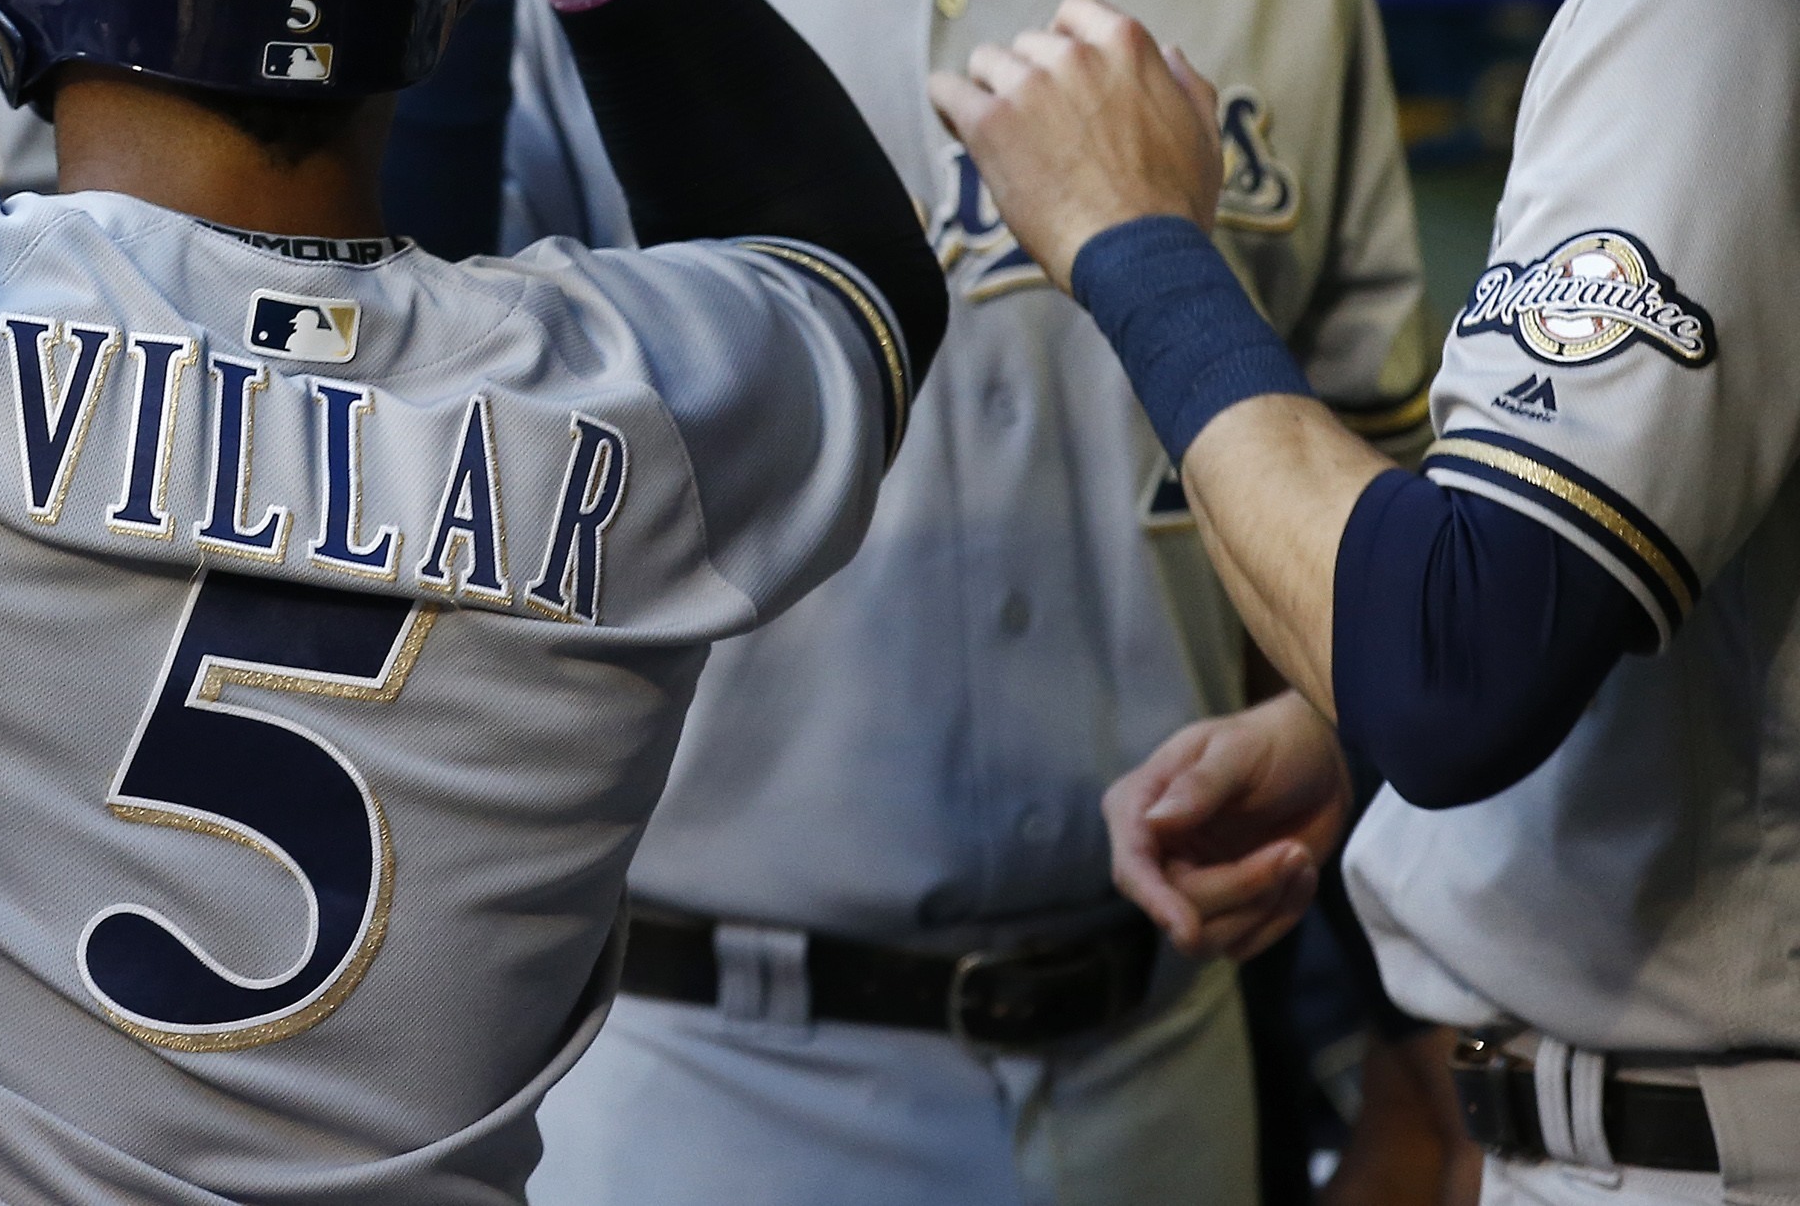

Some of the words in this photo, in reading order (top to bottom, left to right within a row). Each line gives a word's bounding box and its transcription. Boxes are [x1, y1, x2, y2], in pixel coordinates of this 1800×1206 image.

[1462, 260, 1706, 356] Milwaukee
[1, 316, 630, 627] VILLAR
[1490, 396, 1556, 424] Majestic
[75, 572, 438, 1054] 5
